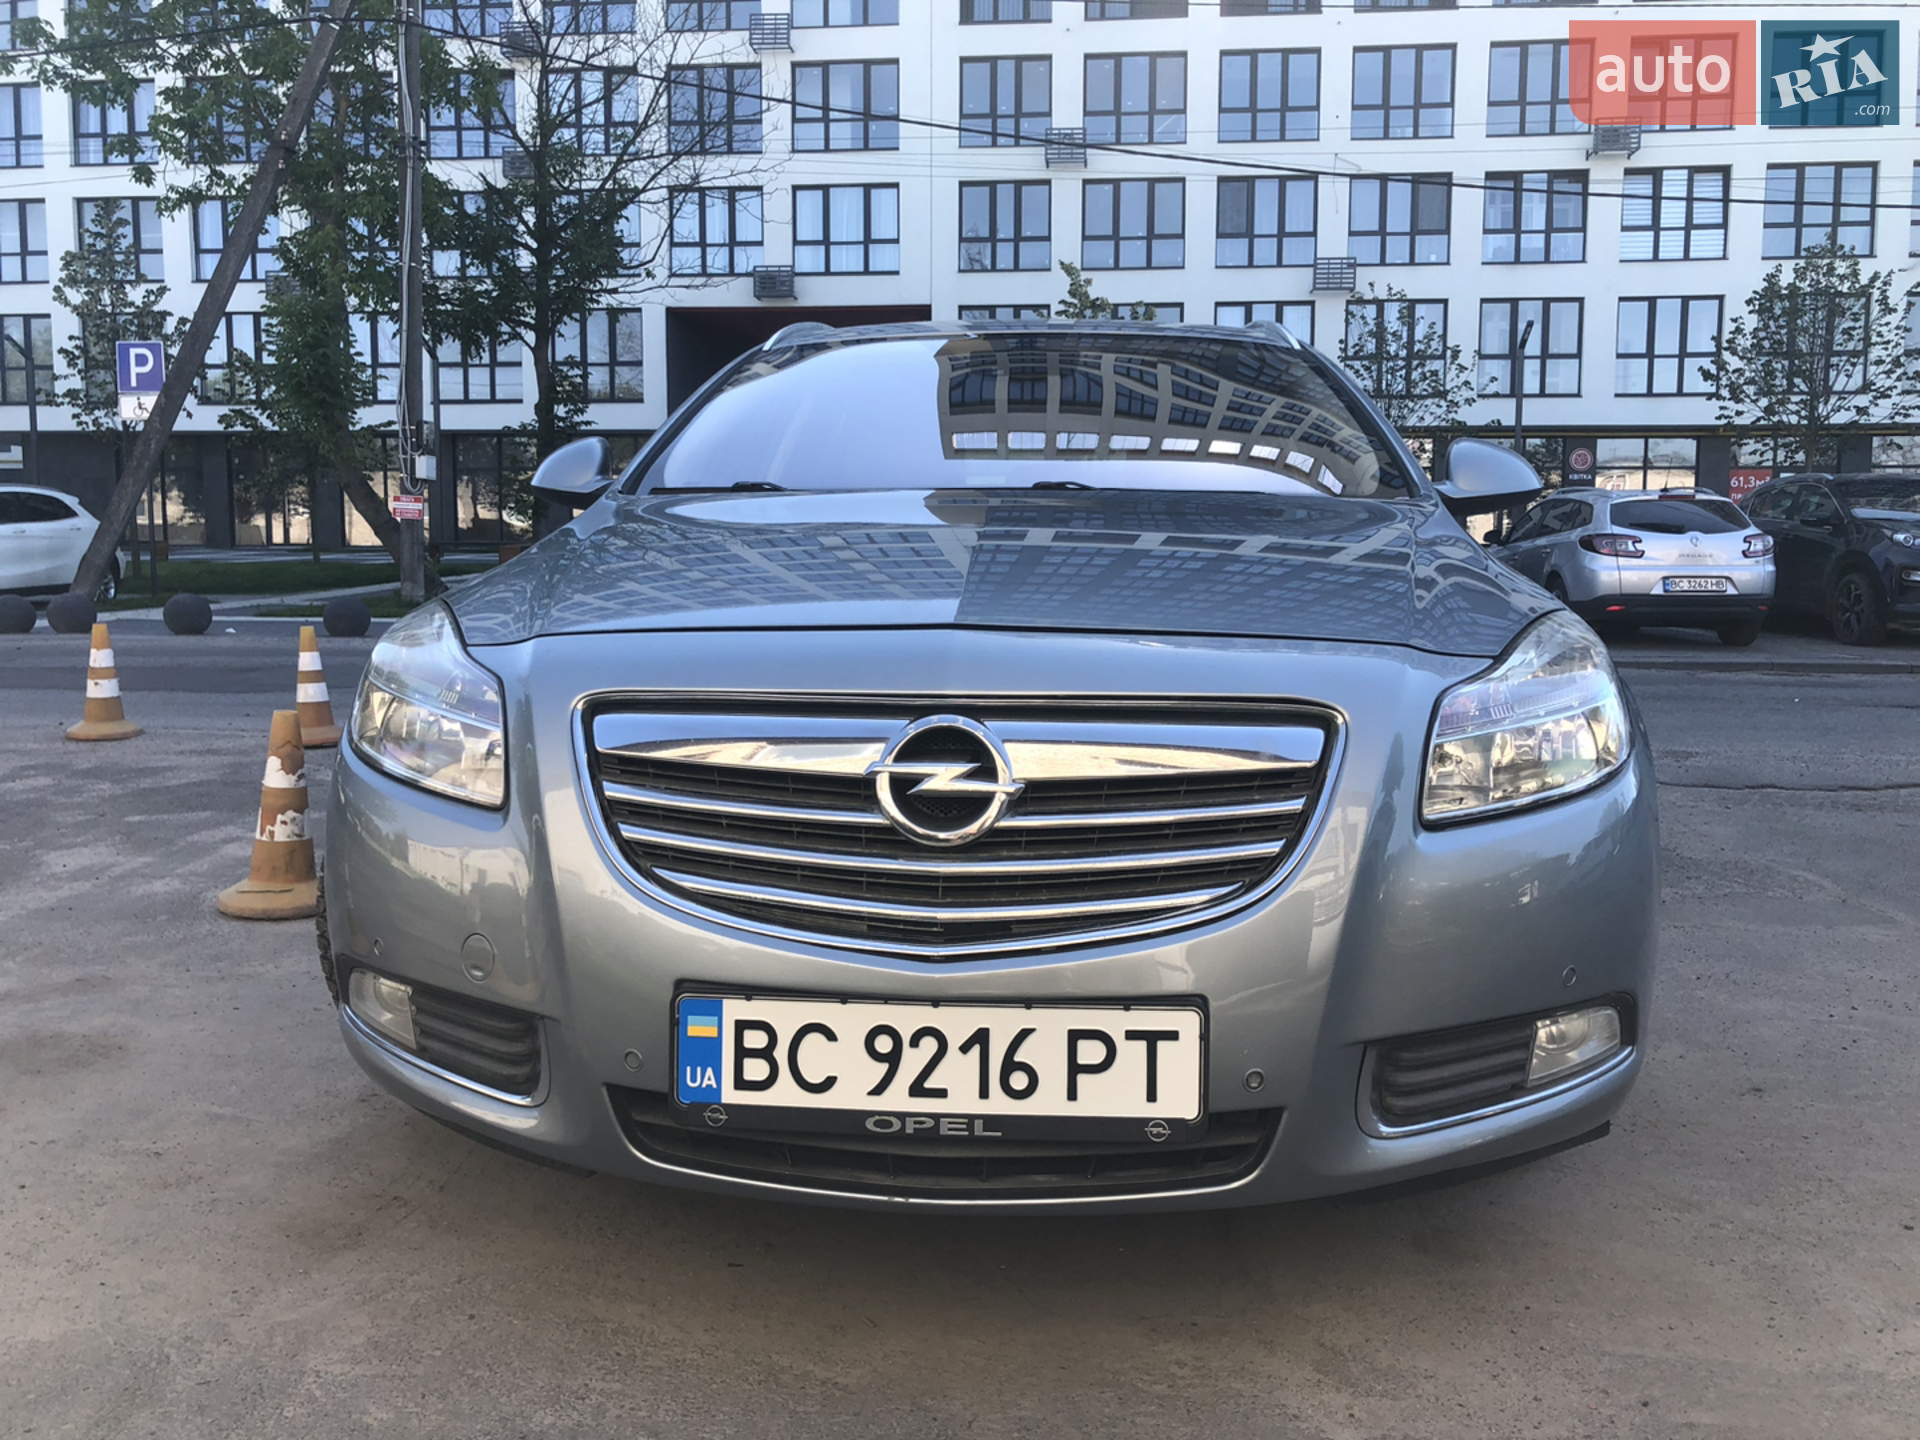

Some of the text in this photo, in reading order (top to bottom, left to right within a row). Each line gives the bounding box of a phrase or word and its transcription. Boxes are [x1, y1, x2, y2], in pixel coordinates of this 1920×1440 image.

[129, 347, 154, 388] P
[1687, 579, 1709, 589] 3262
[733, 1019, 1180, 1102] BC 9216 PT
[686, 1066, 717, 1088] UA
[865, 1115, 1002, 1137] OPEL
